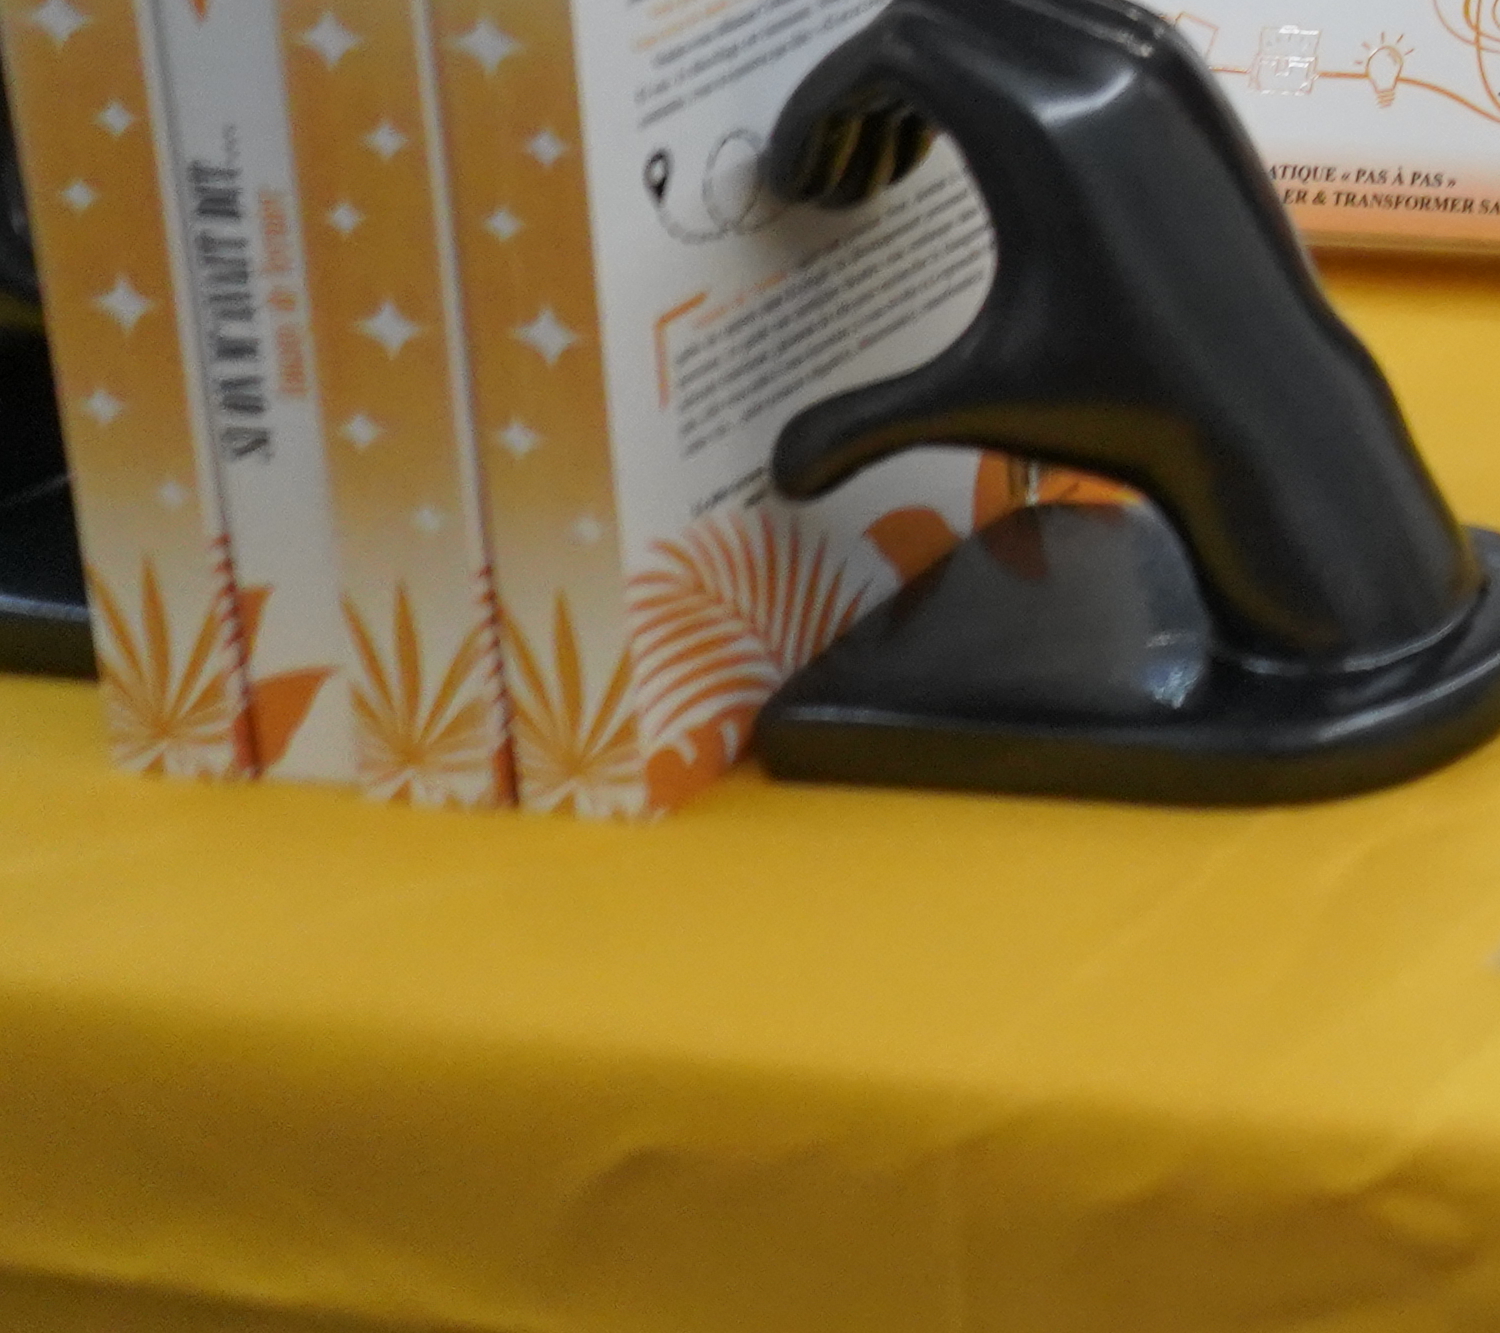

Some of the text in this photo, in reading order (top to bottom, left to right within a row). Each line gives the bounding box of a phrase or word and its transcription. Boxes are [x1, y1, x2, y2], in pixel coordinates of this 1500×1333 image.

[1268, 164, 1337, 183] ATIQUE
[1354, 168, 1388, 184] PAS
[1410, 171, 1443, 187] PAS
[1311, 189, 1328, 206] &
[1332, 190, 1476, 214] TRANSFORMER
